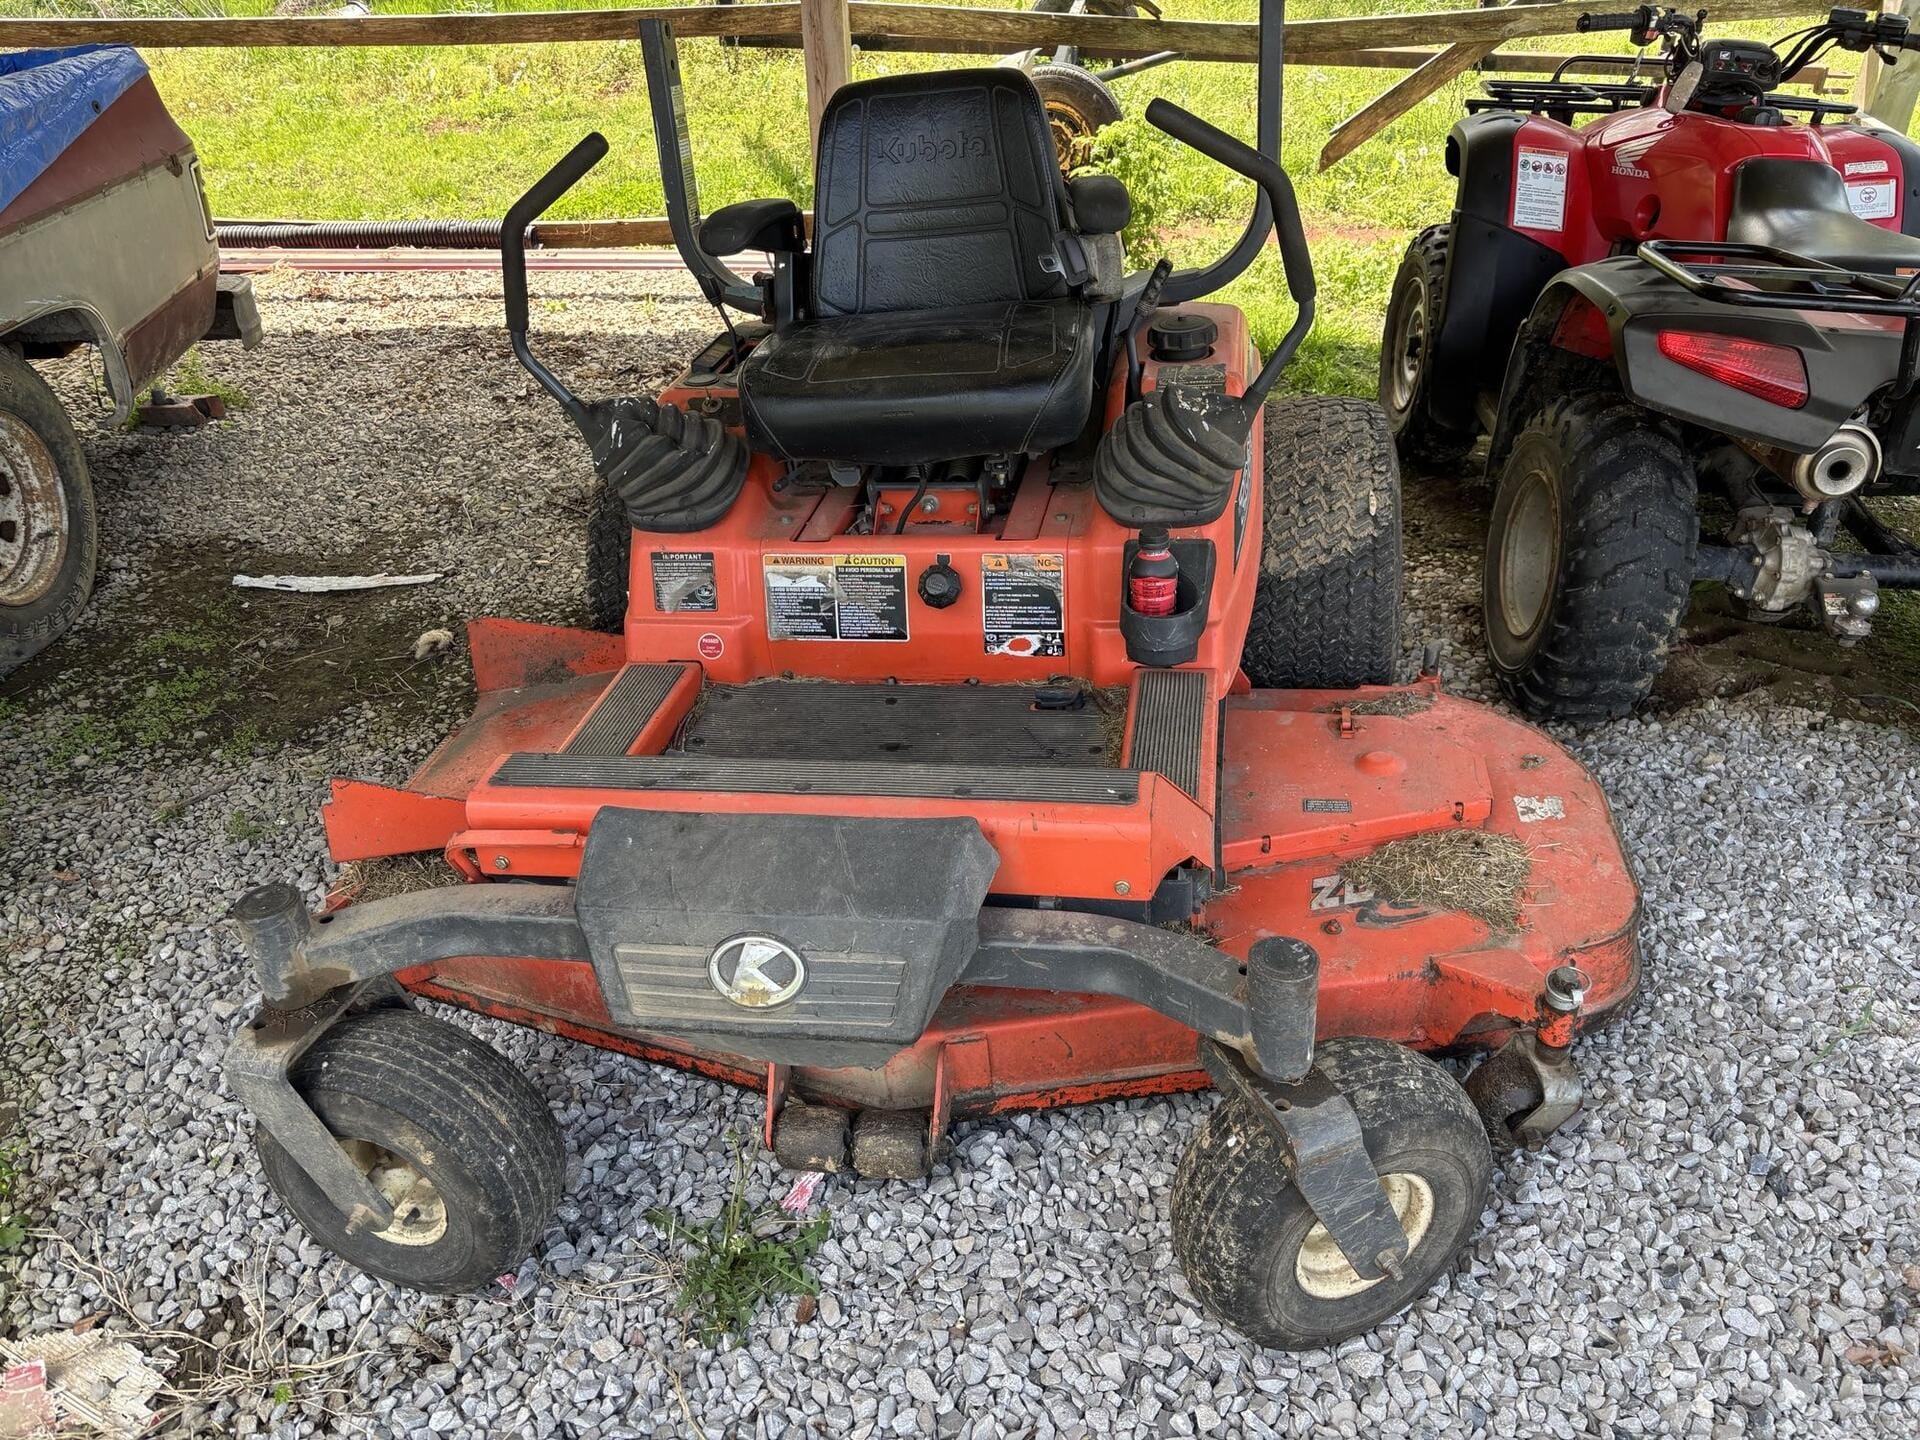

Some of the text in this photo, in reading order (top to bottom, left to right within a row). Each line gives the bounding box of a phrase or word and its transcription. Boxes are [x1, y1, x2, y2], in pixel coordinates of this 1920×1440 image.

[877, 131, 988, 164] Kubota
[1611, 165, 1650, 179] HONDA
[780, 557, 824, 565] WARNING
[853, 557, 895, 565] CAUTION
